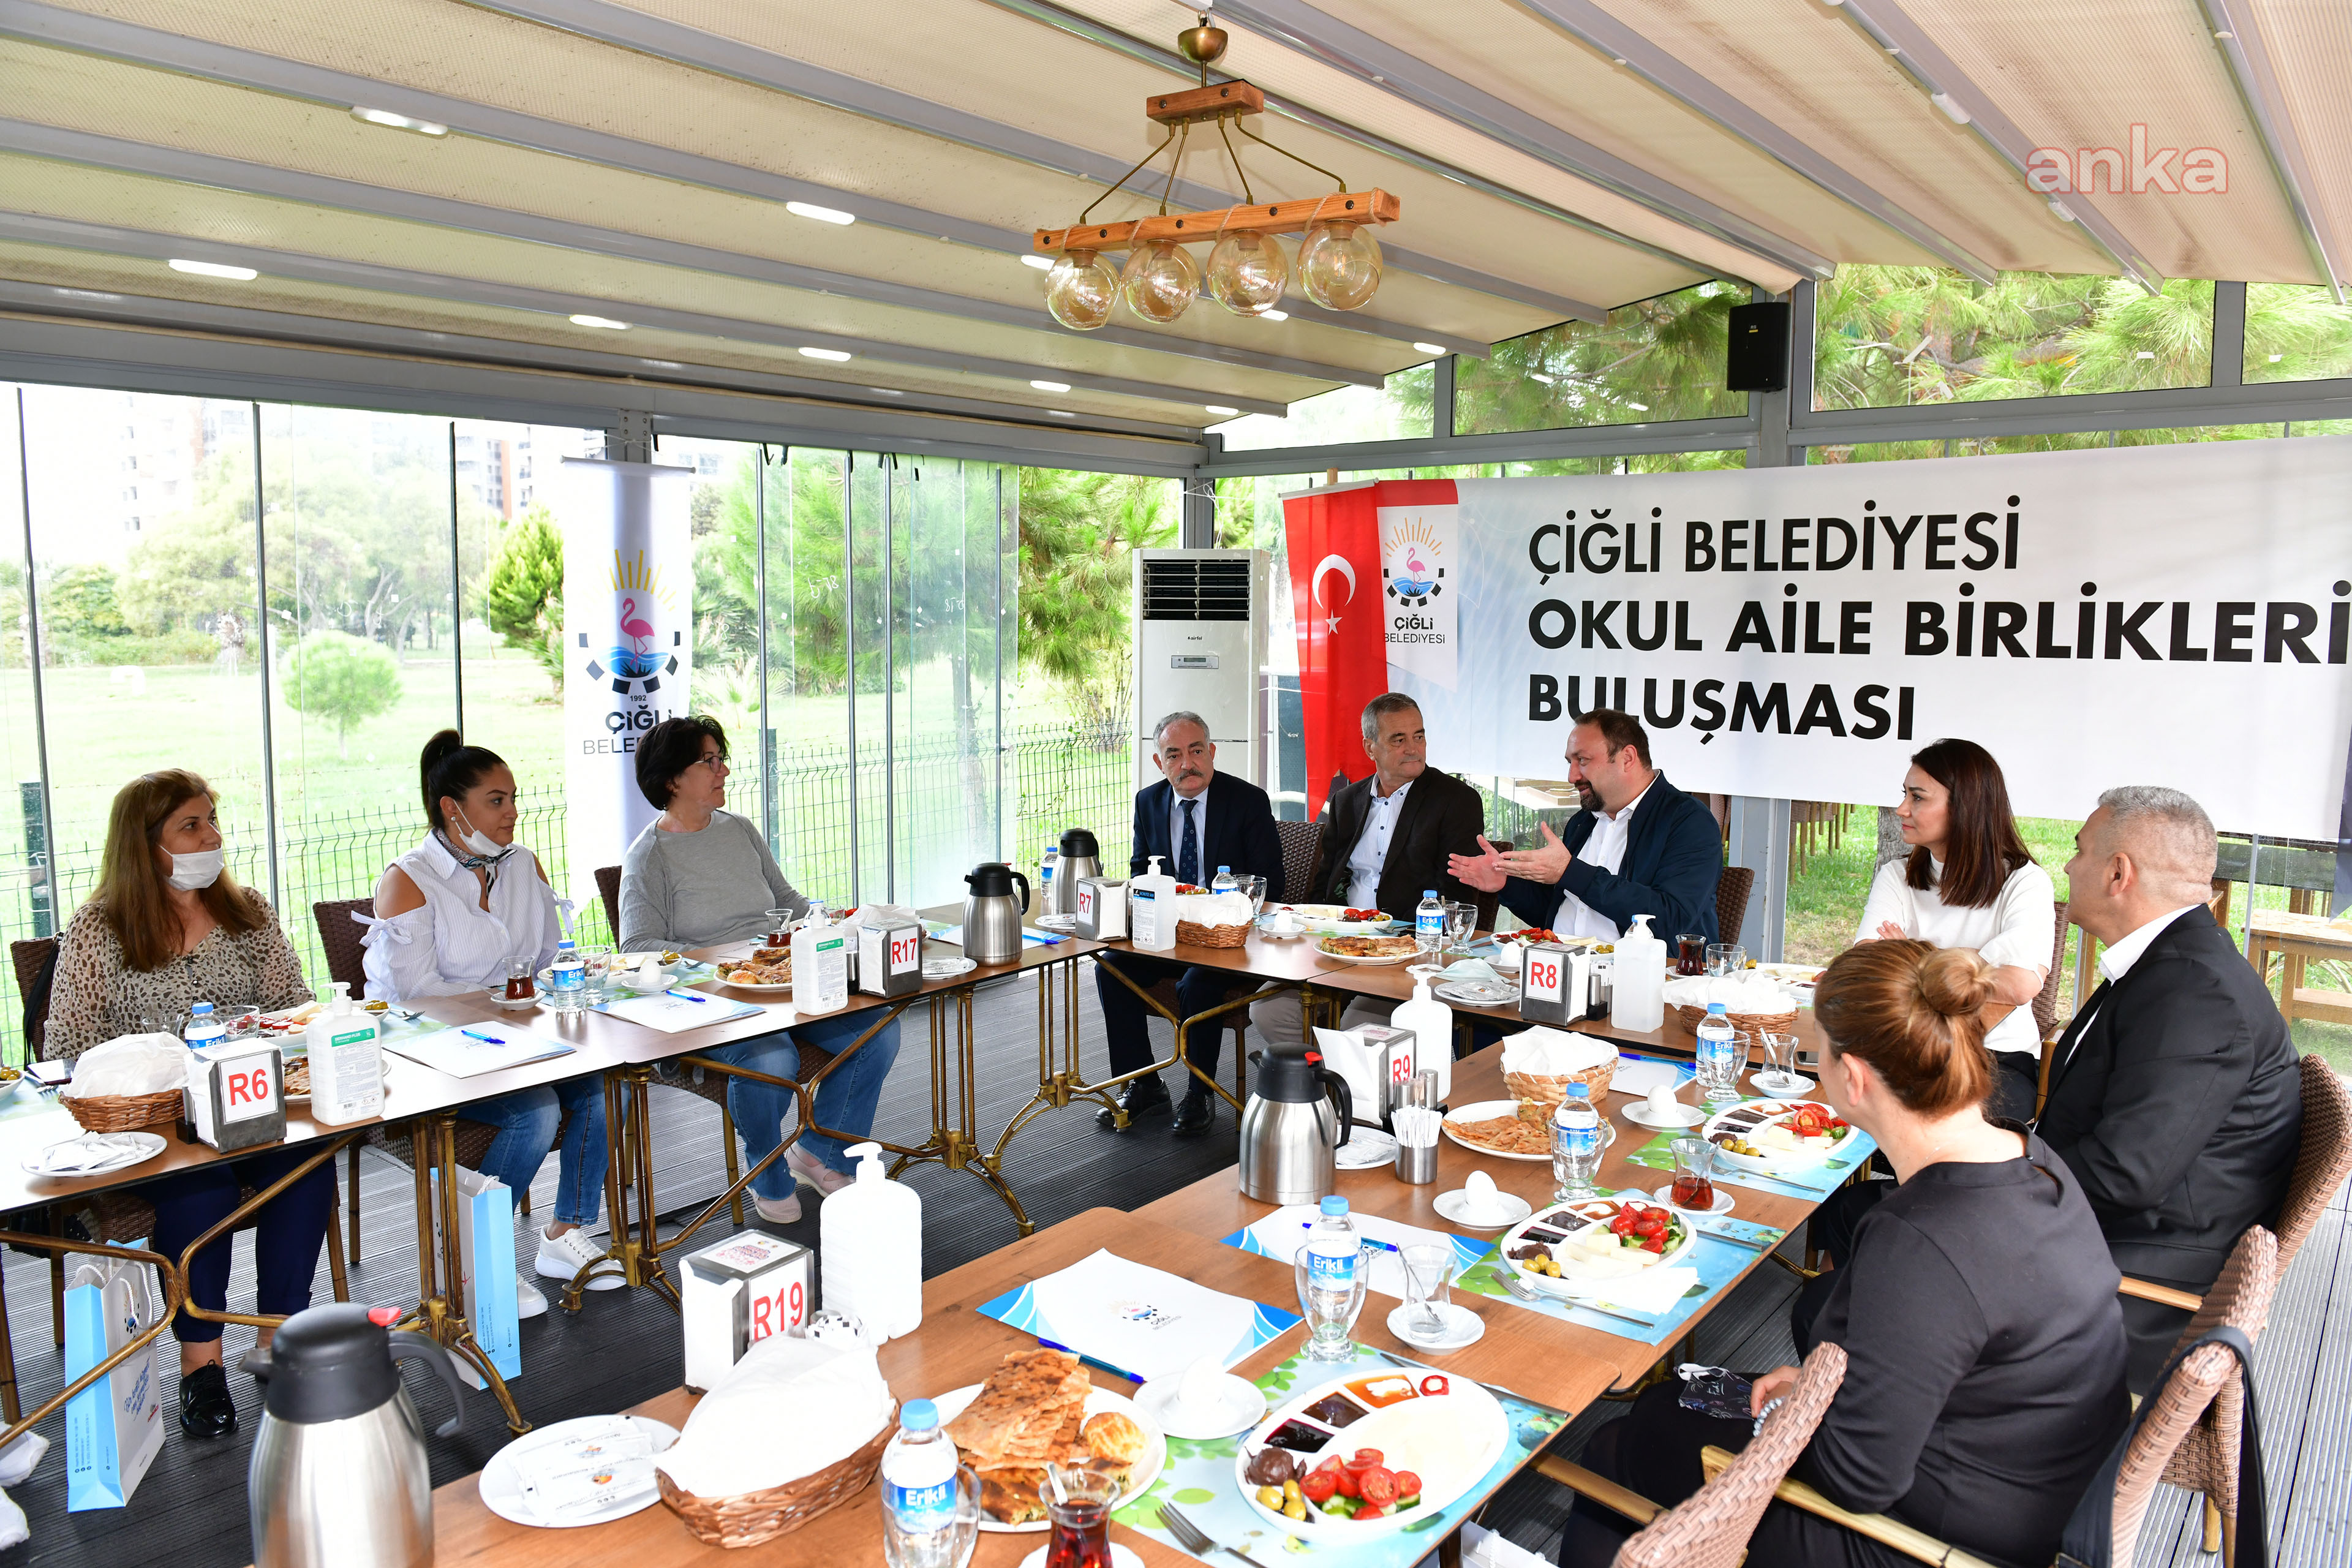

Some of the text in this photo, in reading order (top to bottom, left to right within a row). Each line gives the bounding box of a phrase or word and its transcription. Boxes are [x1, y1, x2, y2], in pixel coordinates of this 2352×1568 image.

[1529, 494, 2020, 586] ÇİĞLİ BELEDİYESİ
[1394, 613, 1433, 631] ÇİĞLİ
[1529, 580, 2351, 664] OKUL AİLE BİRLİKLERİ
[1384, 633, 1446, 644] BELEDİYESİ
[1529, 674, 1914, 745] BULUŞMASI
[1079, 892, 1091, 914] R7
[892, 938, 917, 965] R17
[1531, 961, 1556, 989] R8
[1393, 1054, 1410, 1084] R9
[228, 1068, 268, 1106] R6
[1313, 1256, 1344, 1273] Erikli
[753, 1281, 804, 1341] R19
[905, 1483, 946, 1506] Erikli
